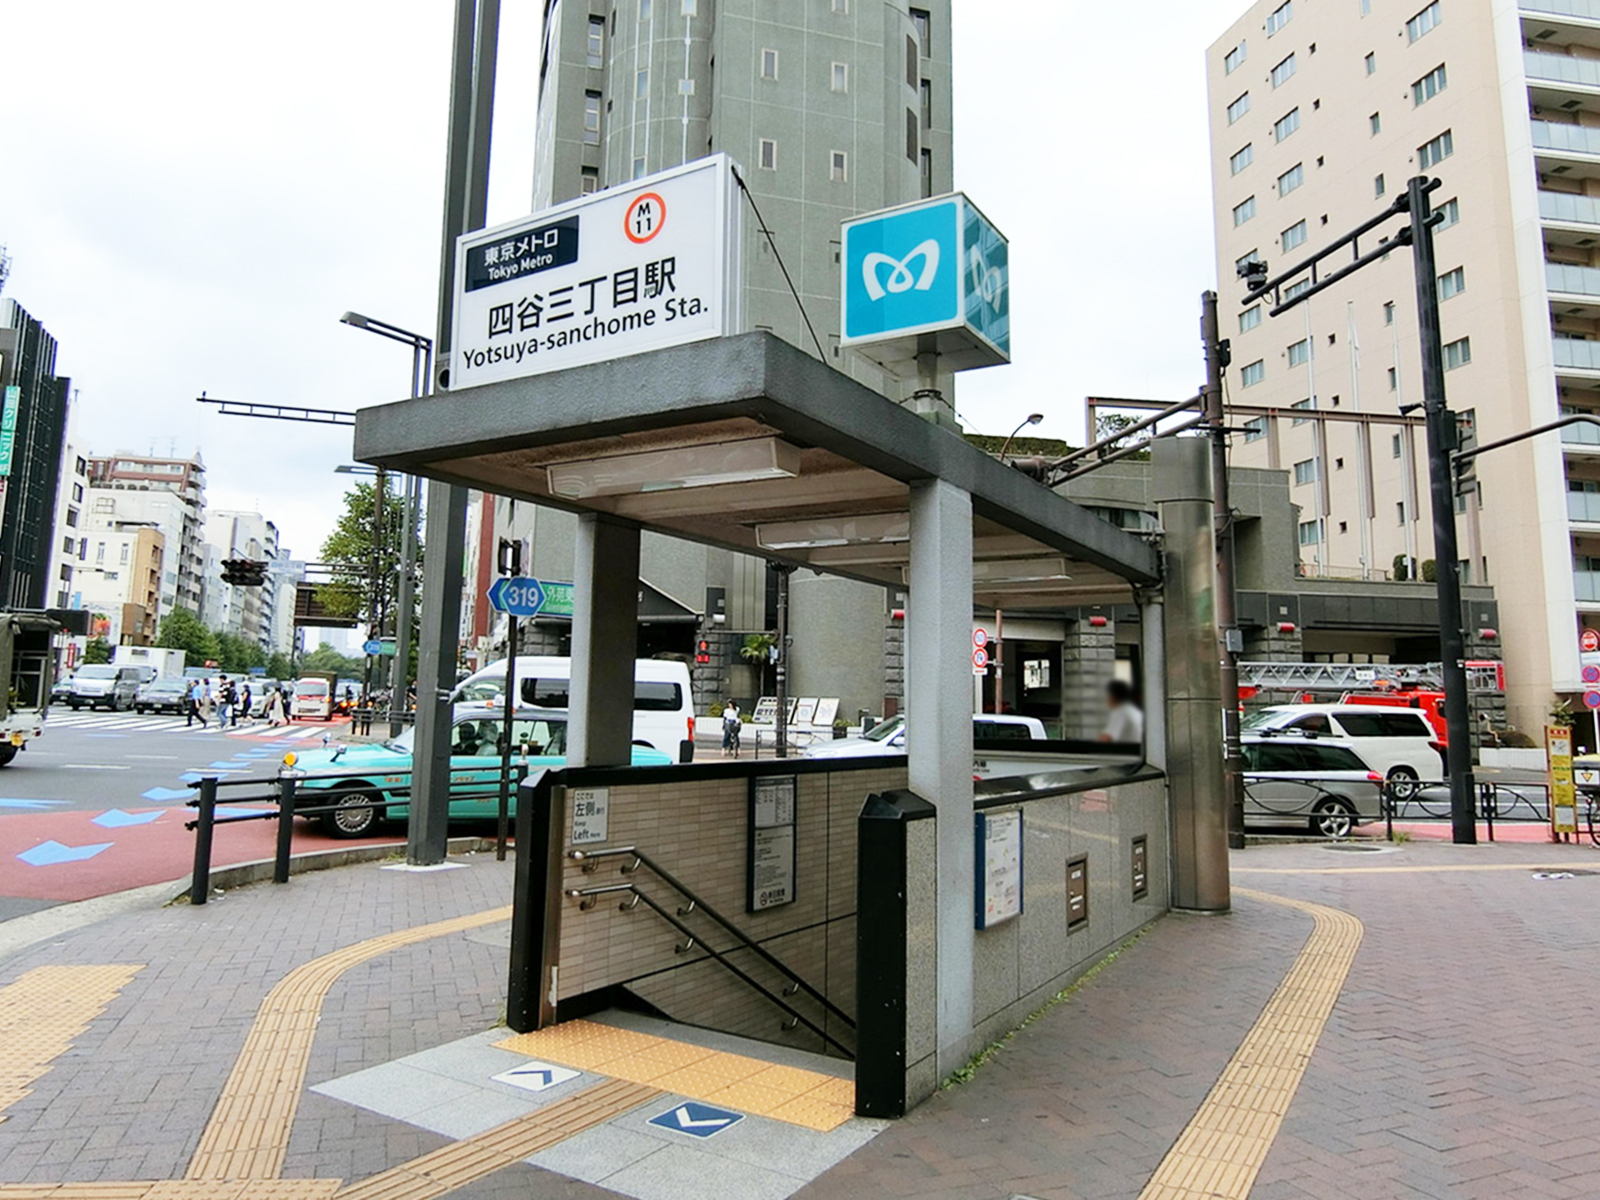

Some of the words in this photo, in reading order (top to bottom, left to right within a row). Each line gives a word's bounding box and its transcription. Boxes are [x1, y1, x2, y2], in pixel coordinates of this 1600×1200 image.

[637, 202, 651, 217] M
[636, 217, 652, 234] 11
[484, 229, 558, 266] 東京メトロ
[487, 262, 518, 281] Tokyo
[520, 252, 553, 271] Metro
[488, 256, 677, 339] 四谷三丁目駅
[463, 308, 656, 369] Yotsuya-sanchome
[665, 295, 709, 322] Sta.
[508, 586, 539, 607] 319
[574, 828, 590, 840] Left
